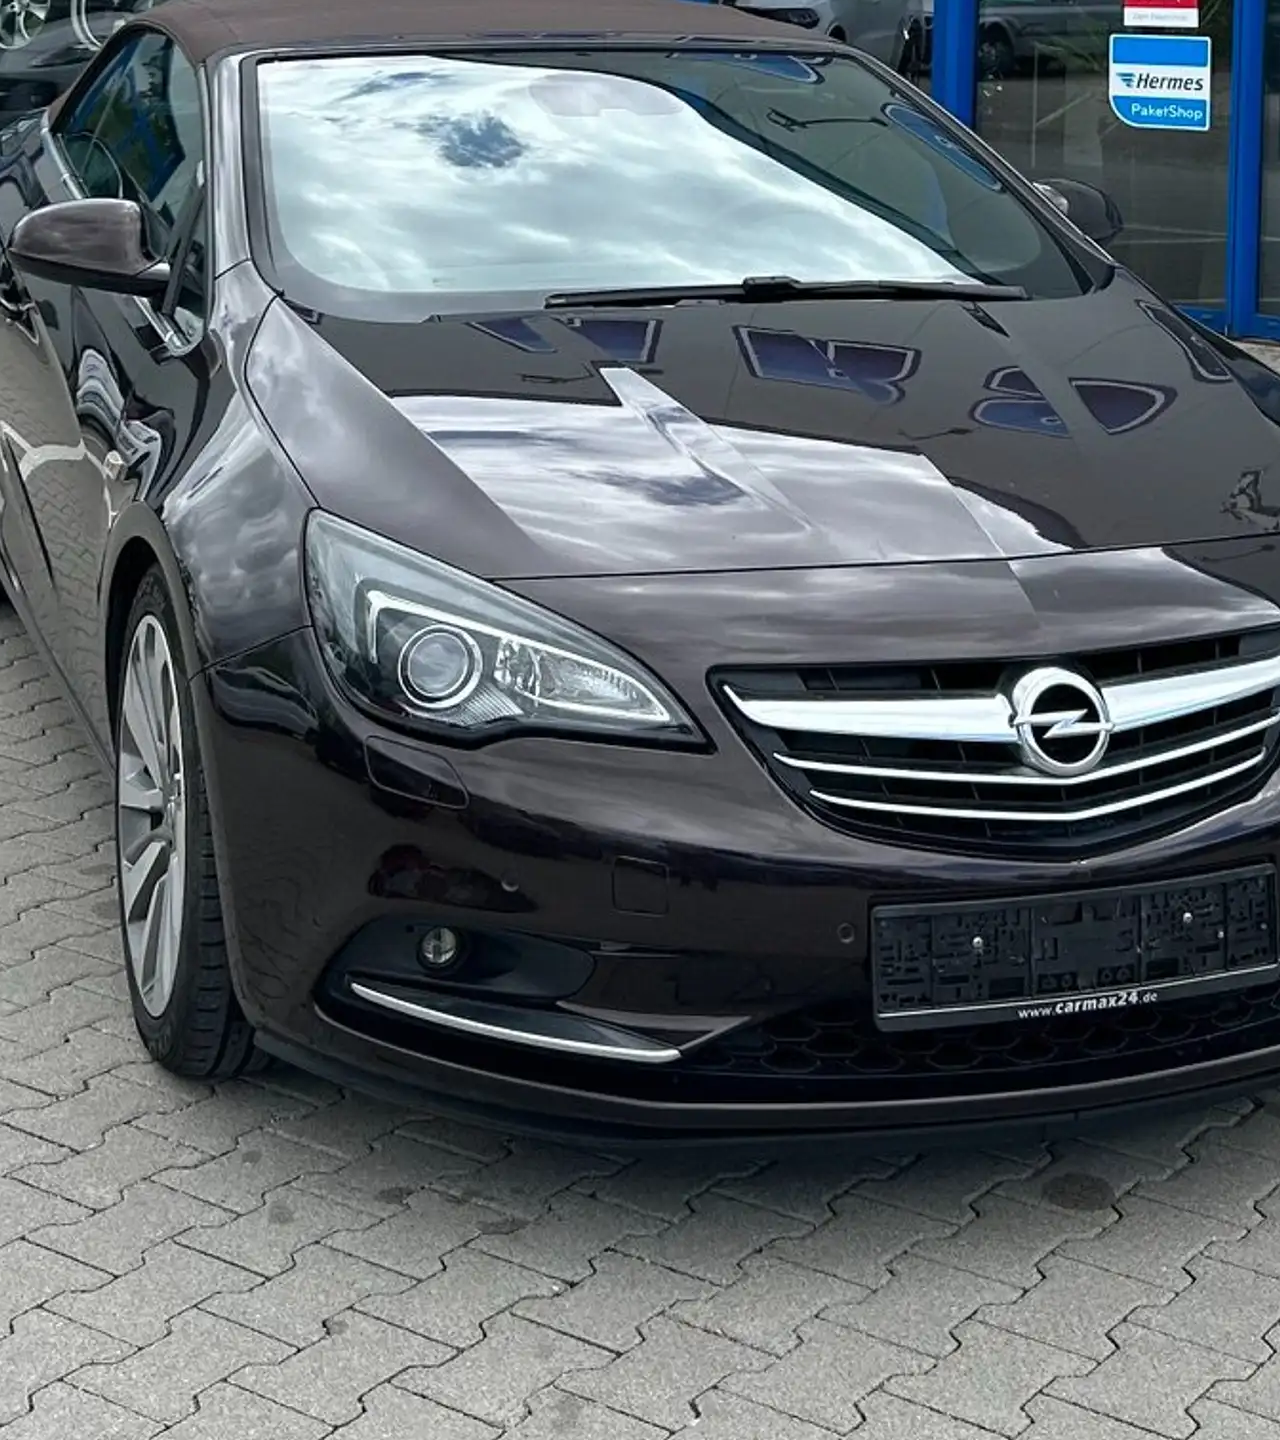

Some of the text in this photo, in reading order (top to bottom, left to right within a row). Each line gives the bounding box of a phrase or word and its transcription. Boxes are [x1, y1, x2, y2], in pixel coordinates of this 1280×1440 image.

[1136, 72, 1205, 91] Hermes
[1131, 103, 1203, 121] PaketShop
[1017, 991, 1159, 1020] www.carmax24.de
